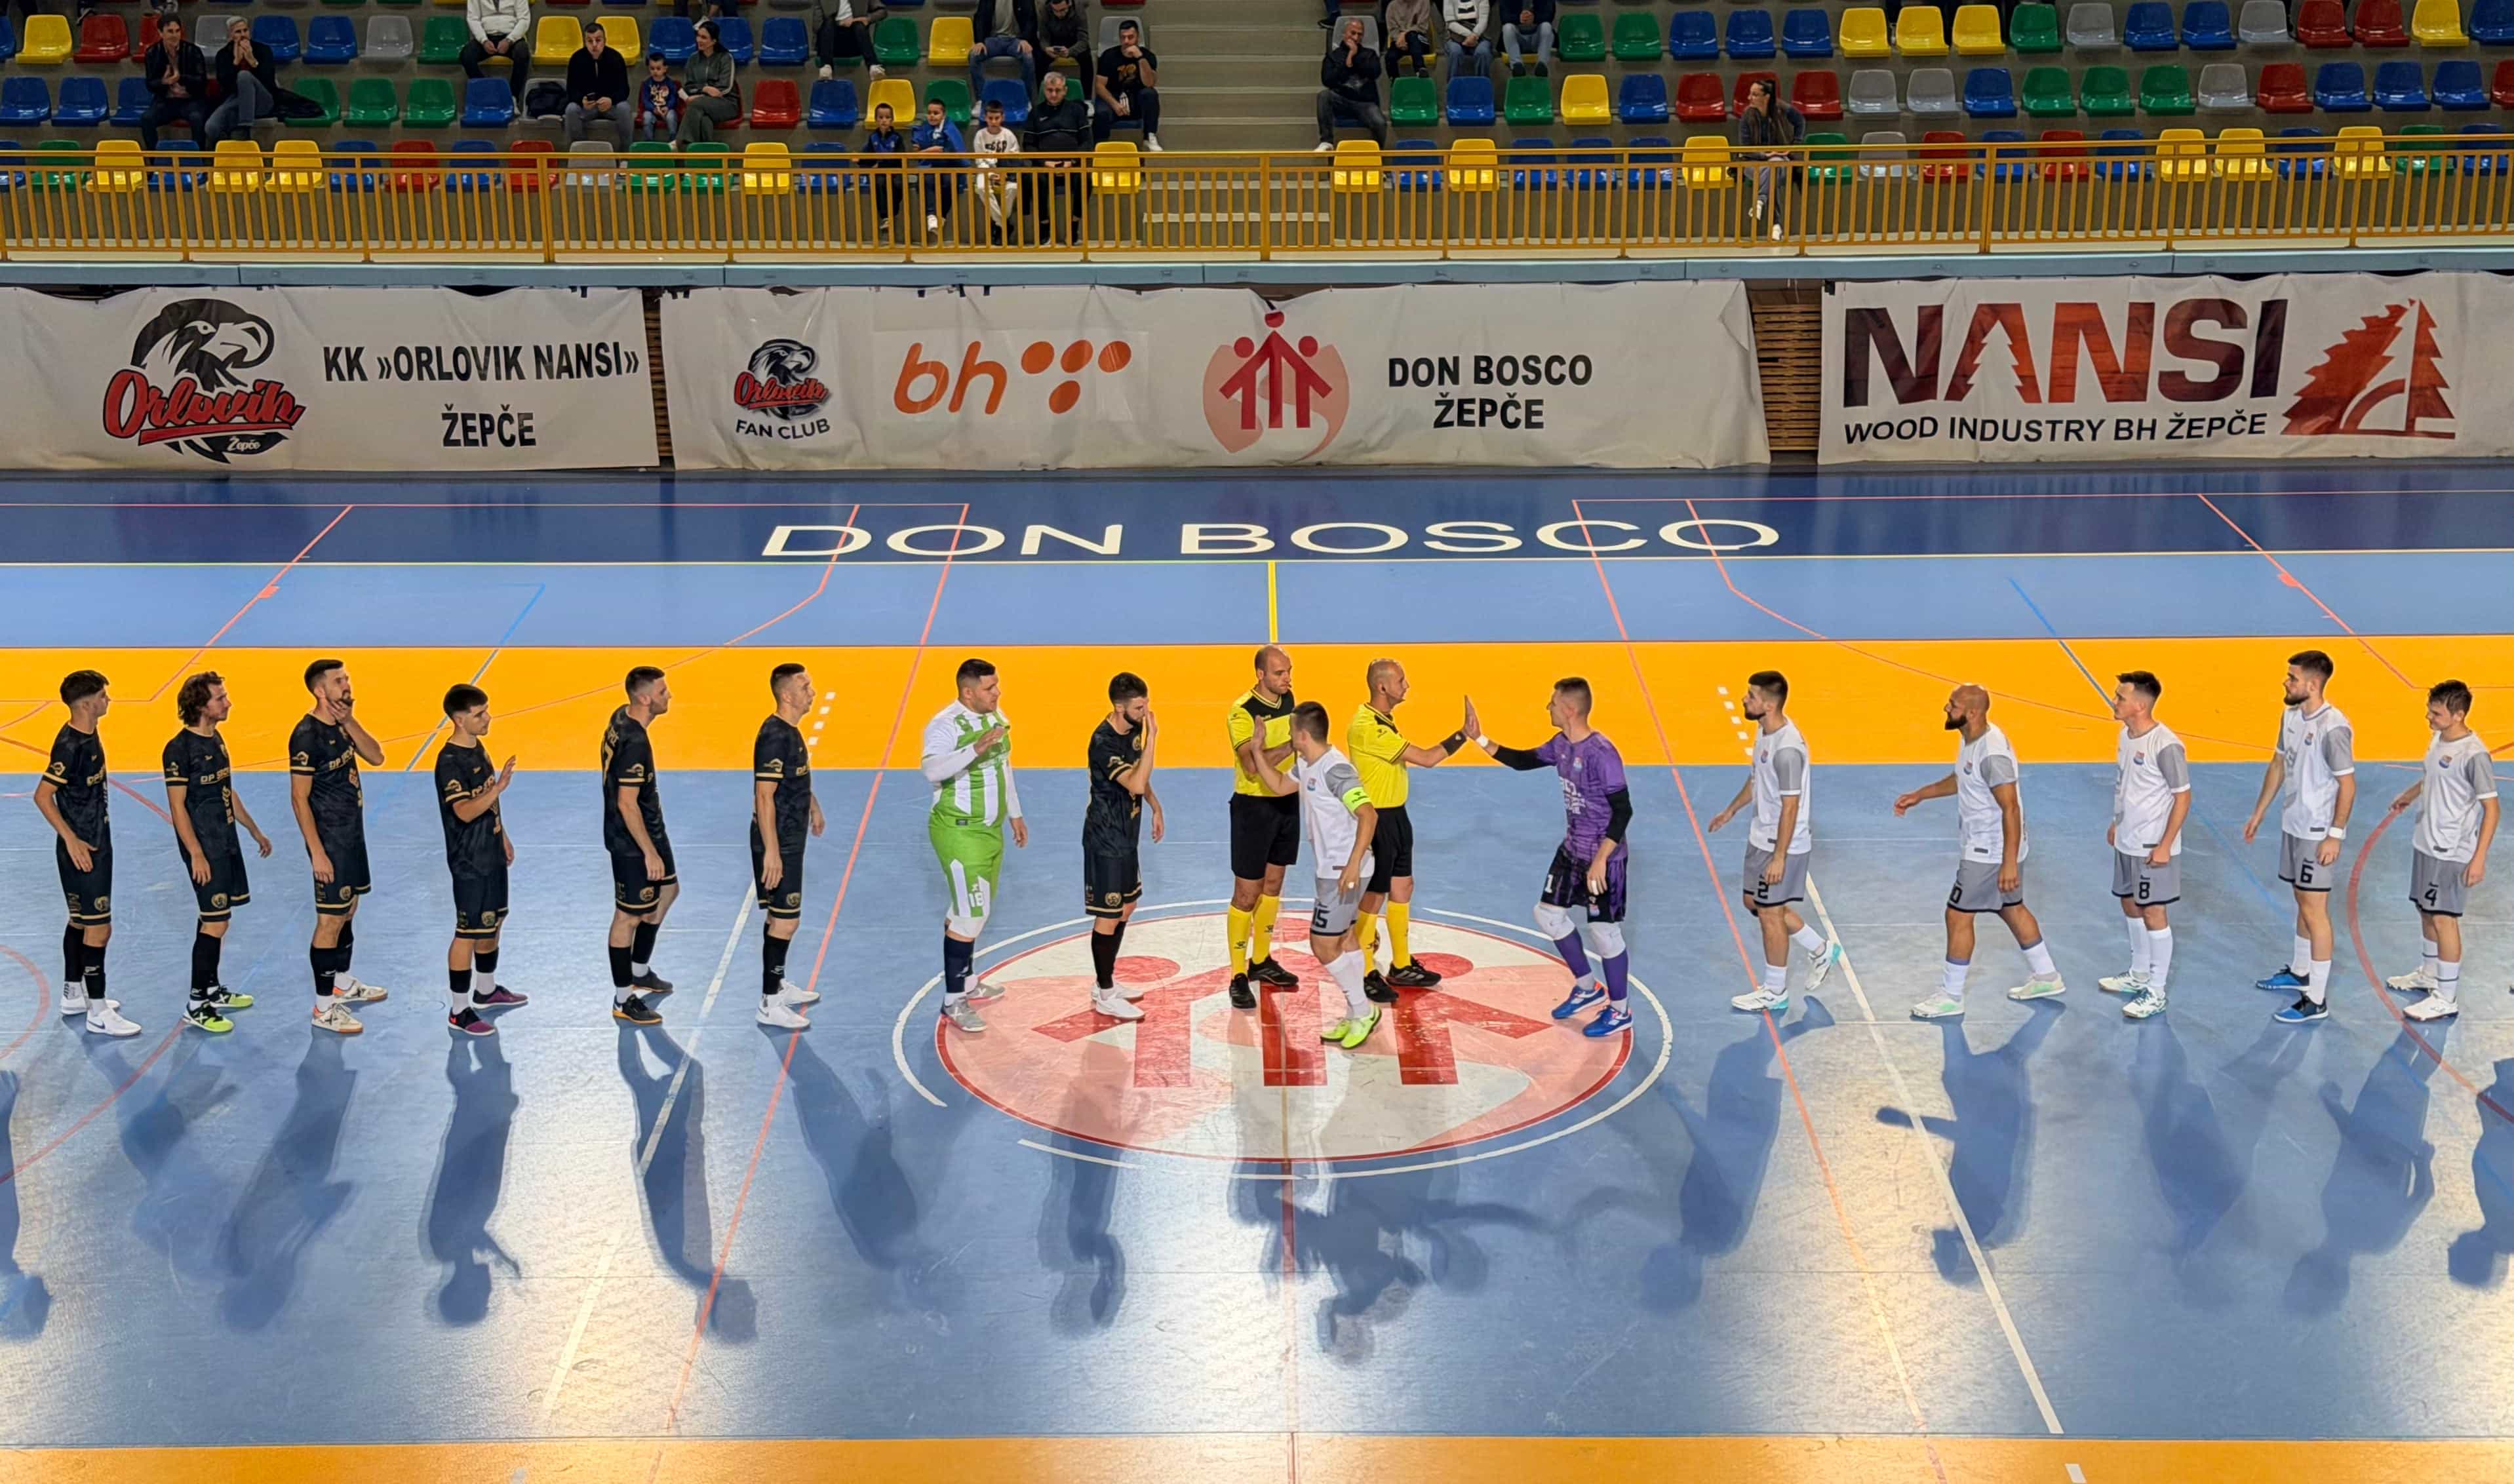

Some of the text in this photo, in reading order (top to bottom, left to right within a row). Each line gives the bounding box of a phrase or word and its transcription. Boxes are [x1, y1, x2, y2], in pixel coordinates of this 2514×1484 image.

[323, 346, 368, 381] KK
[1843, 298, 2288, 408] NANSI
[1388, 355, 1592, 387] DON BOSCO
[103, 369, 307, 439] Orlovik
[1433, 392, 1544, 429] ŽEPČE
[441, 403, 536, 447] ŽEPČE
[736, 418, 830, 439] FAN CLUB
[1845, 409, 2268, 444] WOOD INDUSTRY BH ŽEPČE
[227, 436, 261, 451] Žepče
[762, 518, 1780, 556] DON BOSCO
[1545, 874, 1553, 893] 1
[2300, 864, 2313, 884] 6
[969, 891, 985, 907] 18
[1758, 881, 1769, 899] 2
[2139, 882, 2150, 899] 8
[2424, 888, 2437, 907] 4
[1312, 907, 1330, 928] 15
